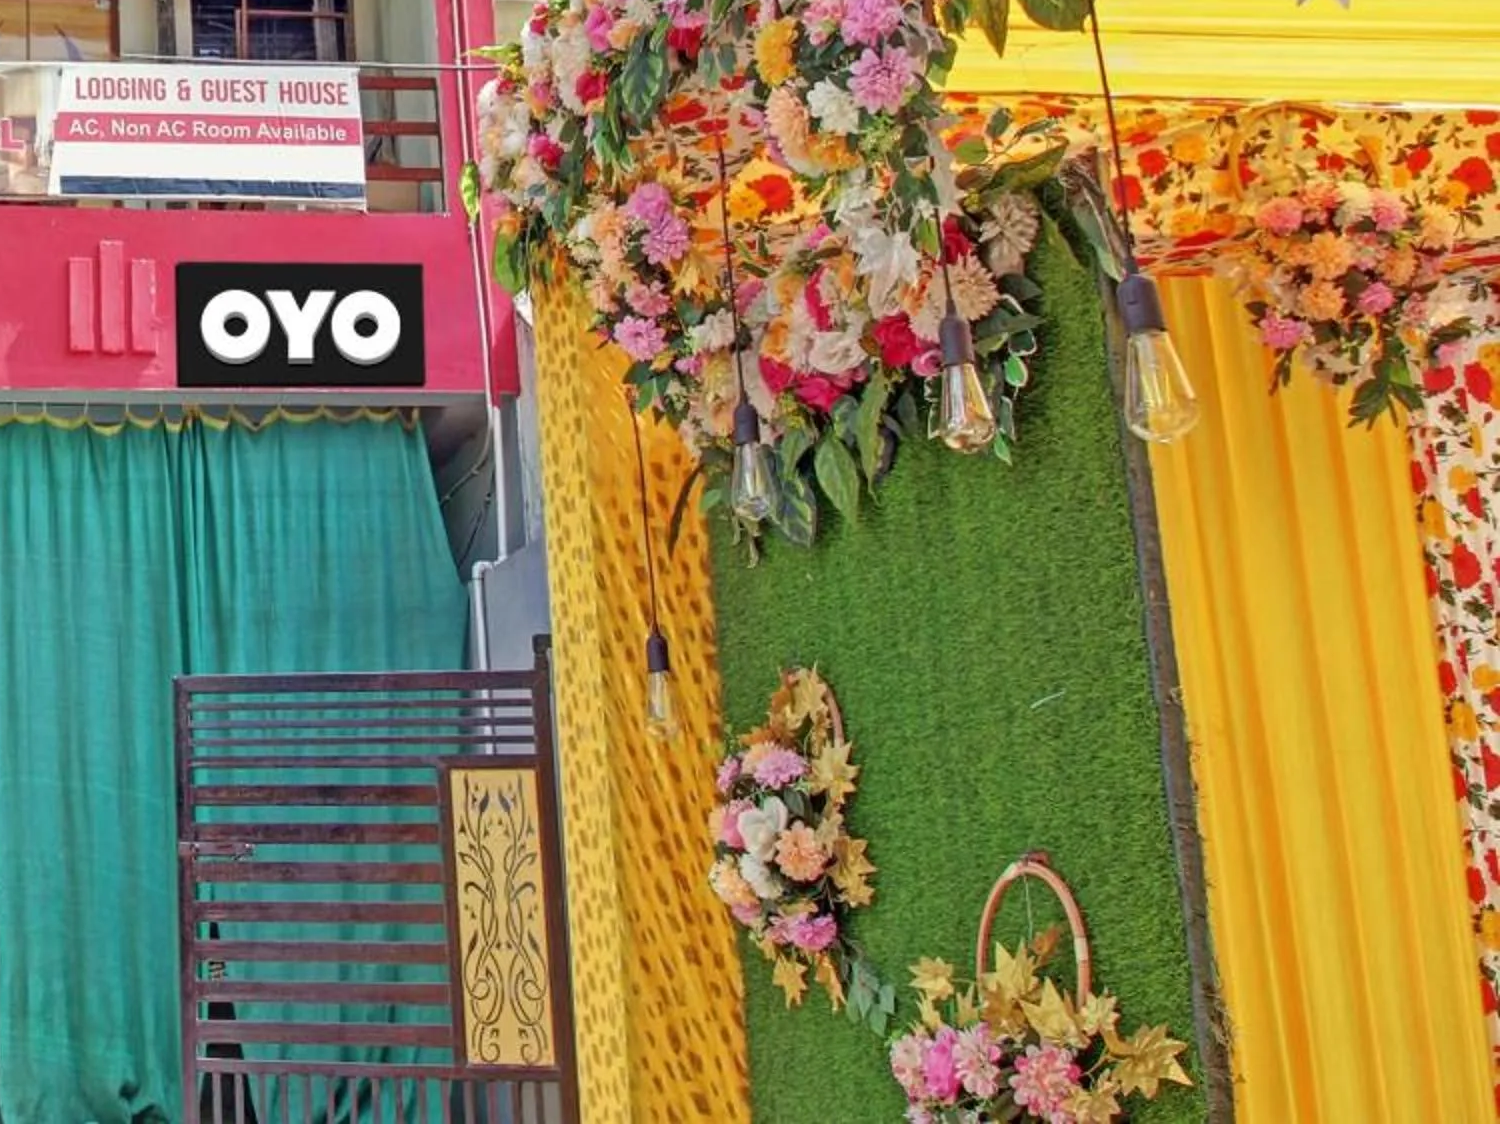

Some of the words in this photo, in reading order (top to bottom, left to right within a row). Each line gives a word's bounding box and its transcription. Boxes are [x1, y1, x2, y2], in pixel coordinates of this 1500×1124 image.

[74, 76, 167, 102] LODGING
[176, 79, 192, 102] &
[200, 79, 269, 104] GUEST
[278, 80, 350, 106] HOUSE
[111, 118, 150, 137] Non
[156, 119, 187, 138] AC
[192, 120, 251, 139] Room
[256, 122, 348, 142] Available
[200, 288, 401, 365] OYO
